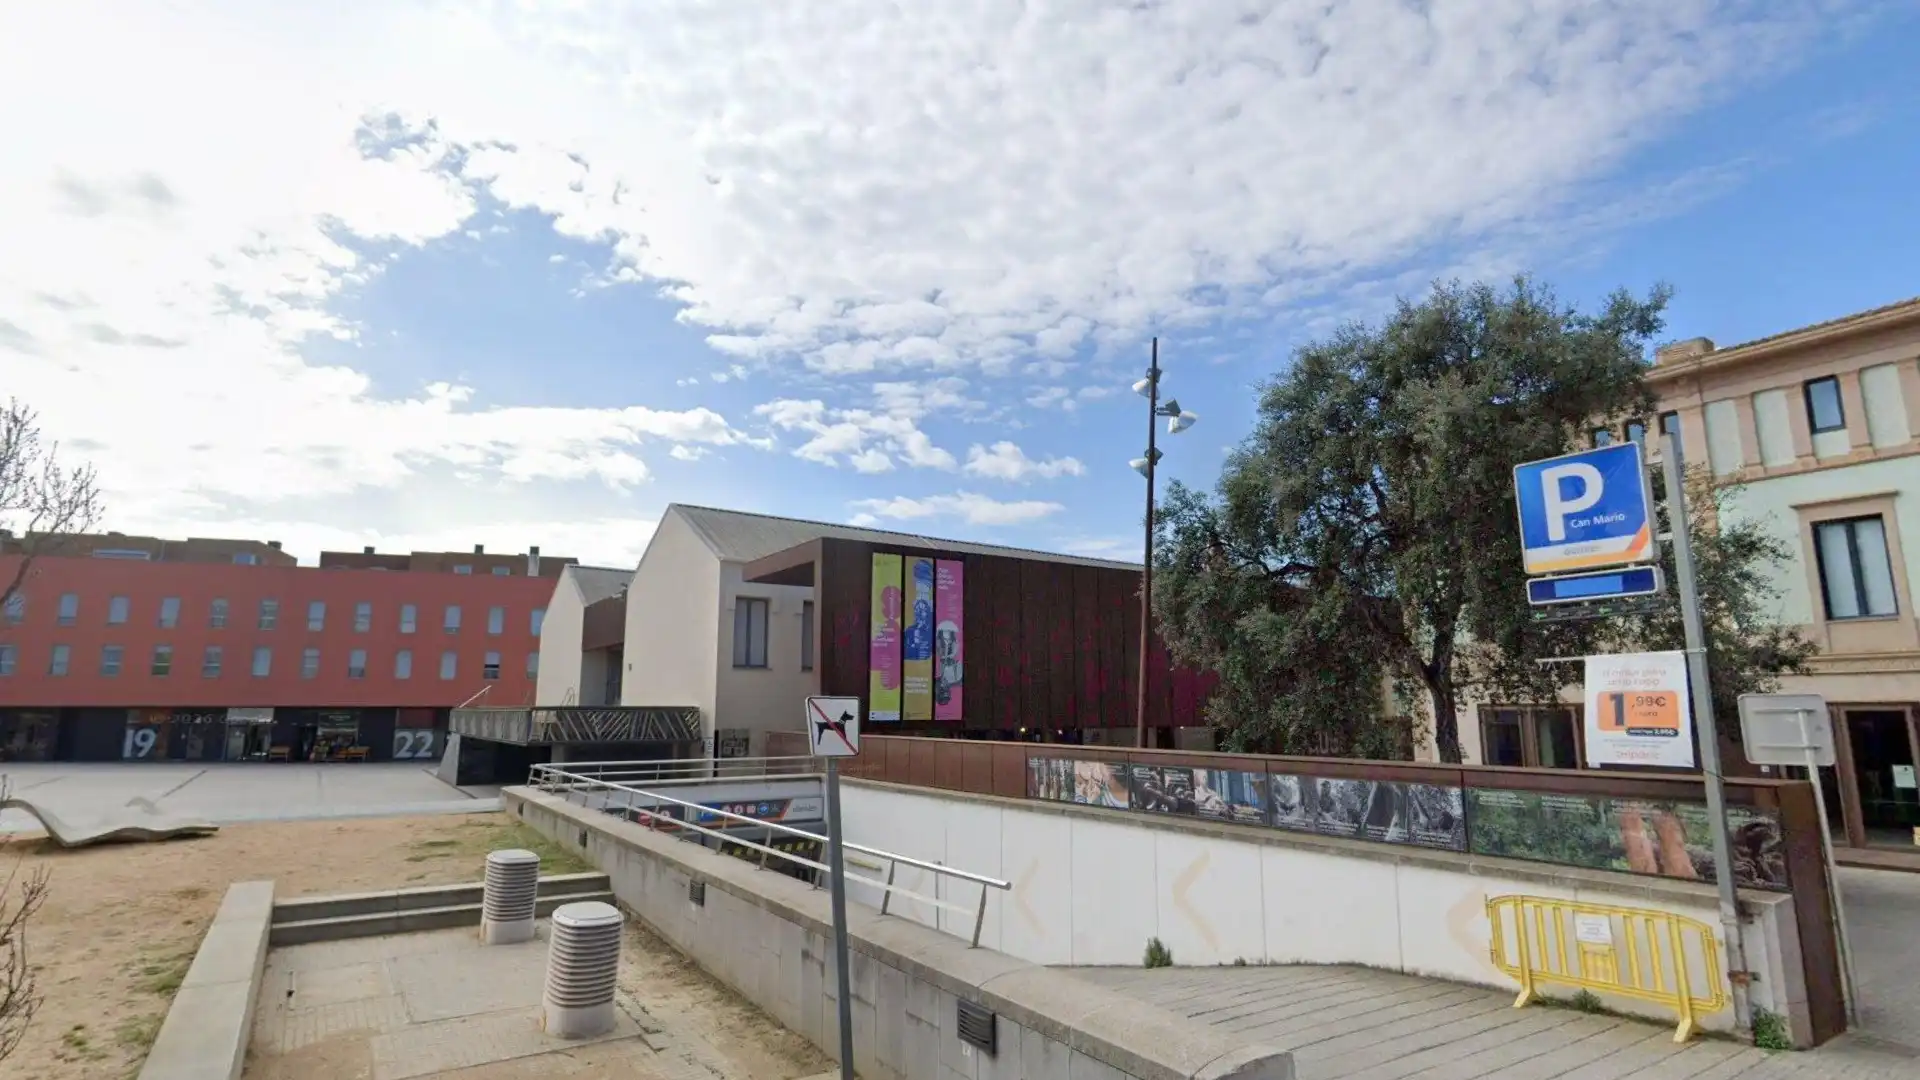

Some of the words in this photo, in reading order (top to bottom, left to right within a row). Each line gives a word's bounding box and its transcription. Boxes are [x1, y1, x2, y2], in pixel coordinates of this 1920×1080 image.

[1541, 462, 1604, 541] P
[1570, 518, 1591, 529] Can
[122, 728, 157, 758] 19
[395, 731, 434, 758] 22
